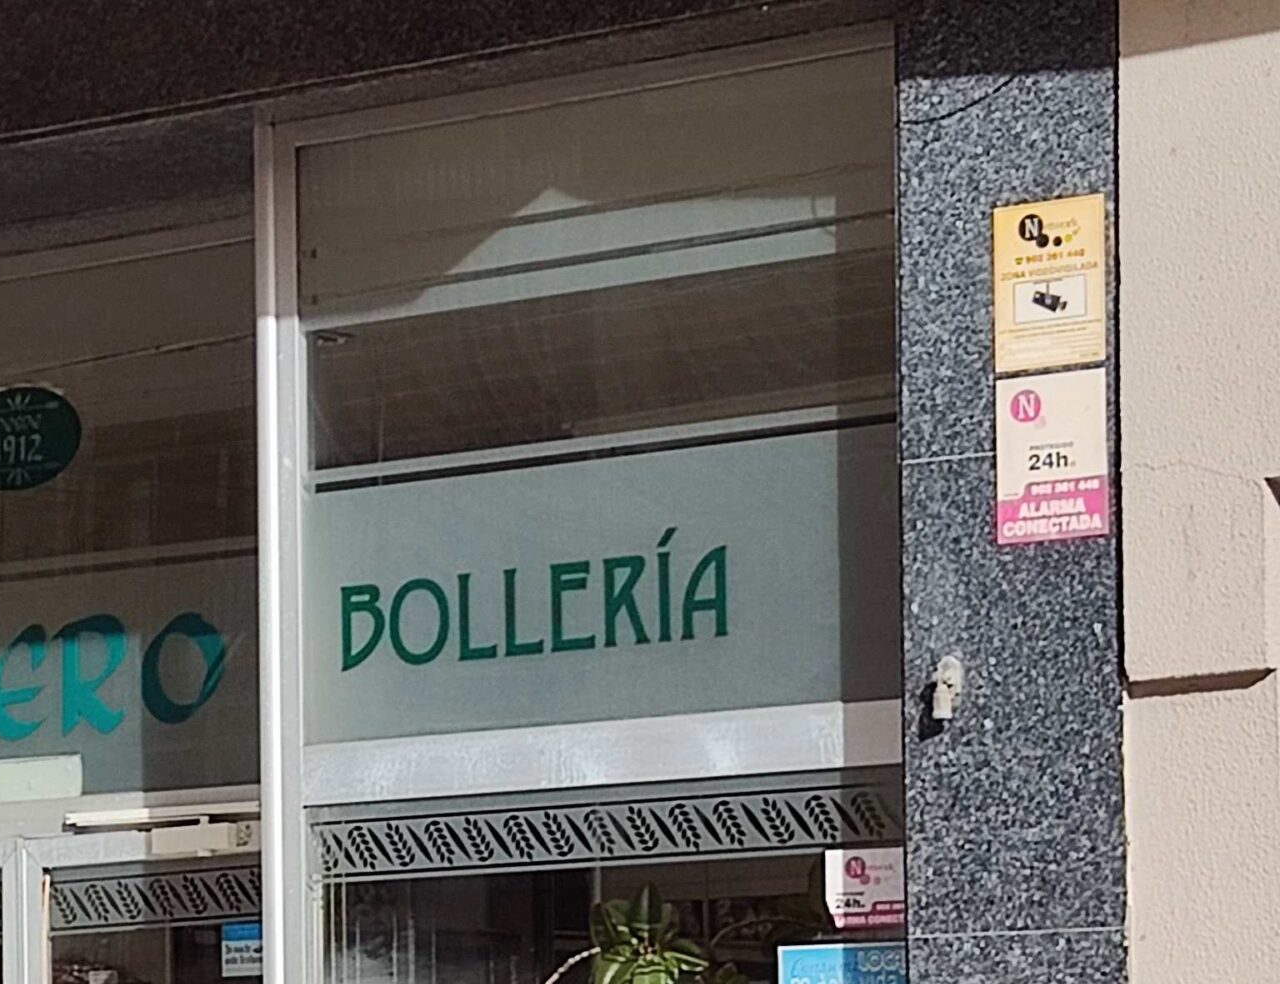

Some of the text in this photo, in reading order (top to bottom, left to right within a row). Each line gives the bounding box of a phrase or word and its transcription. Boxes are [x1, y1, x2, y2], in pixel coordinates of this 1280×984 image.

[1019, 498, 1087, 519] ALARMA
[1002, 513, 1102, 538] CONECTADA
[340, 526, 729, 673] BOLLERÍA
